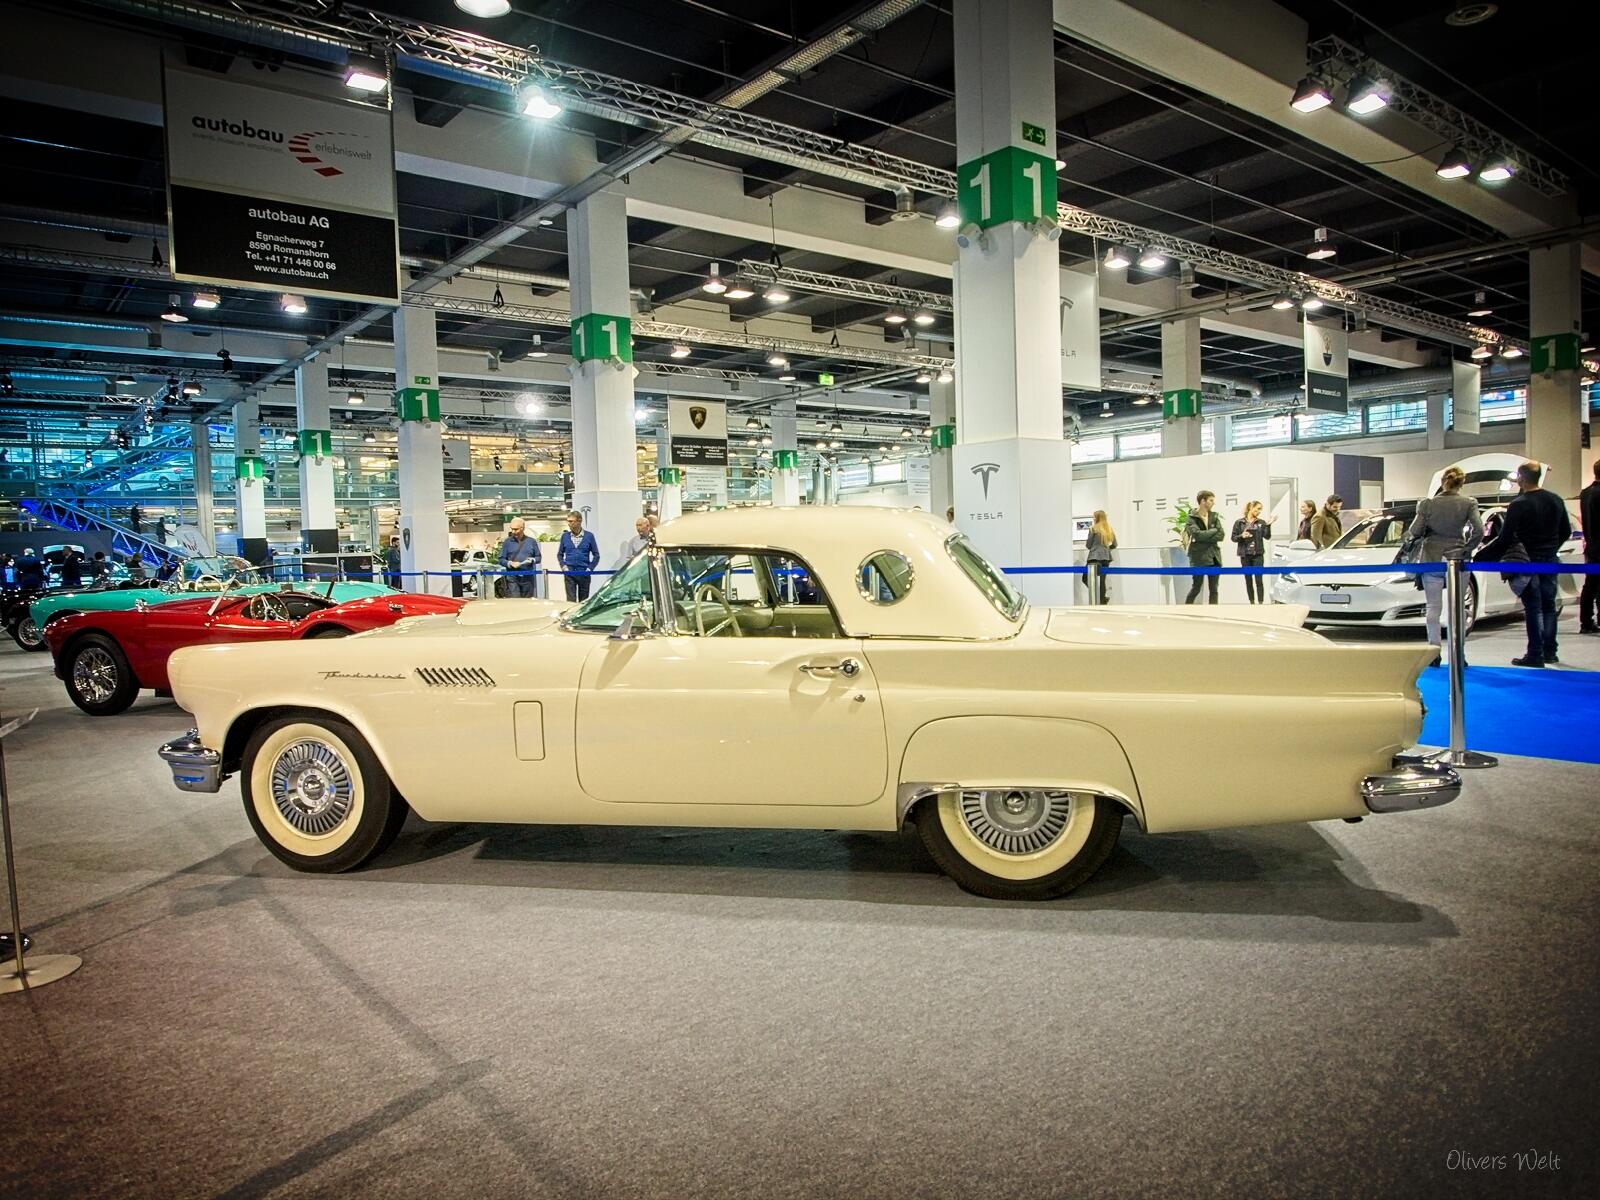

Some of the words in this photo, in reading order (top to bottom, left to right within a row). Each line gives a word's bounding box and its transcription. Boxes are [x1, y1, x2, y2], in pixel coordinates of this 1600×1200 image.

[191, 116, 284, 144] autobau
[315, 142, 372, 160] erlebniswelt
[970, 163, 991, 220] 1
[1023, 161, 1042, 218] 1
[248, 208, 306, 225] autobau
[309, 215, 330, 228] AG
[255, 231, 317, 248] Egnacherweg
[318, 240, 325, 248] 7
[249, 241, 272, 251] 8590
[273, 243, 330, 259] Romanshorn
[245, 251, 262, 261] Tel.
[265, 254, 281, 263] +41
[283, 255, 294, 265] 71
[295, 258, 312, 268] 446
[313, 260, 325, 269] 00
[325, 262, 337, 271] 66
[254, 264, 330, 280] www.autobau.ch
[575, 321, 586, 357] 1
[601, 320, 618, 356] 1
[1540, 338, 1557, 367] 1
[415, 392, 429, 418] 1
[1169, 393, 1179, 415] 1
[1190, 392, 1198, 414] 1
[311, 432, 324, 457] 1
[935, 428, 942, 446] 1
[244, 459, 255, 477] 1
[774, 452, 781, 468] 1
[786, 452, 794, 468] 1
[669, 469, 676, 483] 1
[969, 512, 1004, 521] TESLA
[317, 671, 406, 680] Thunderbird
